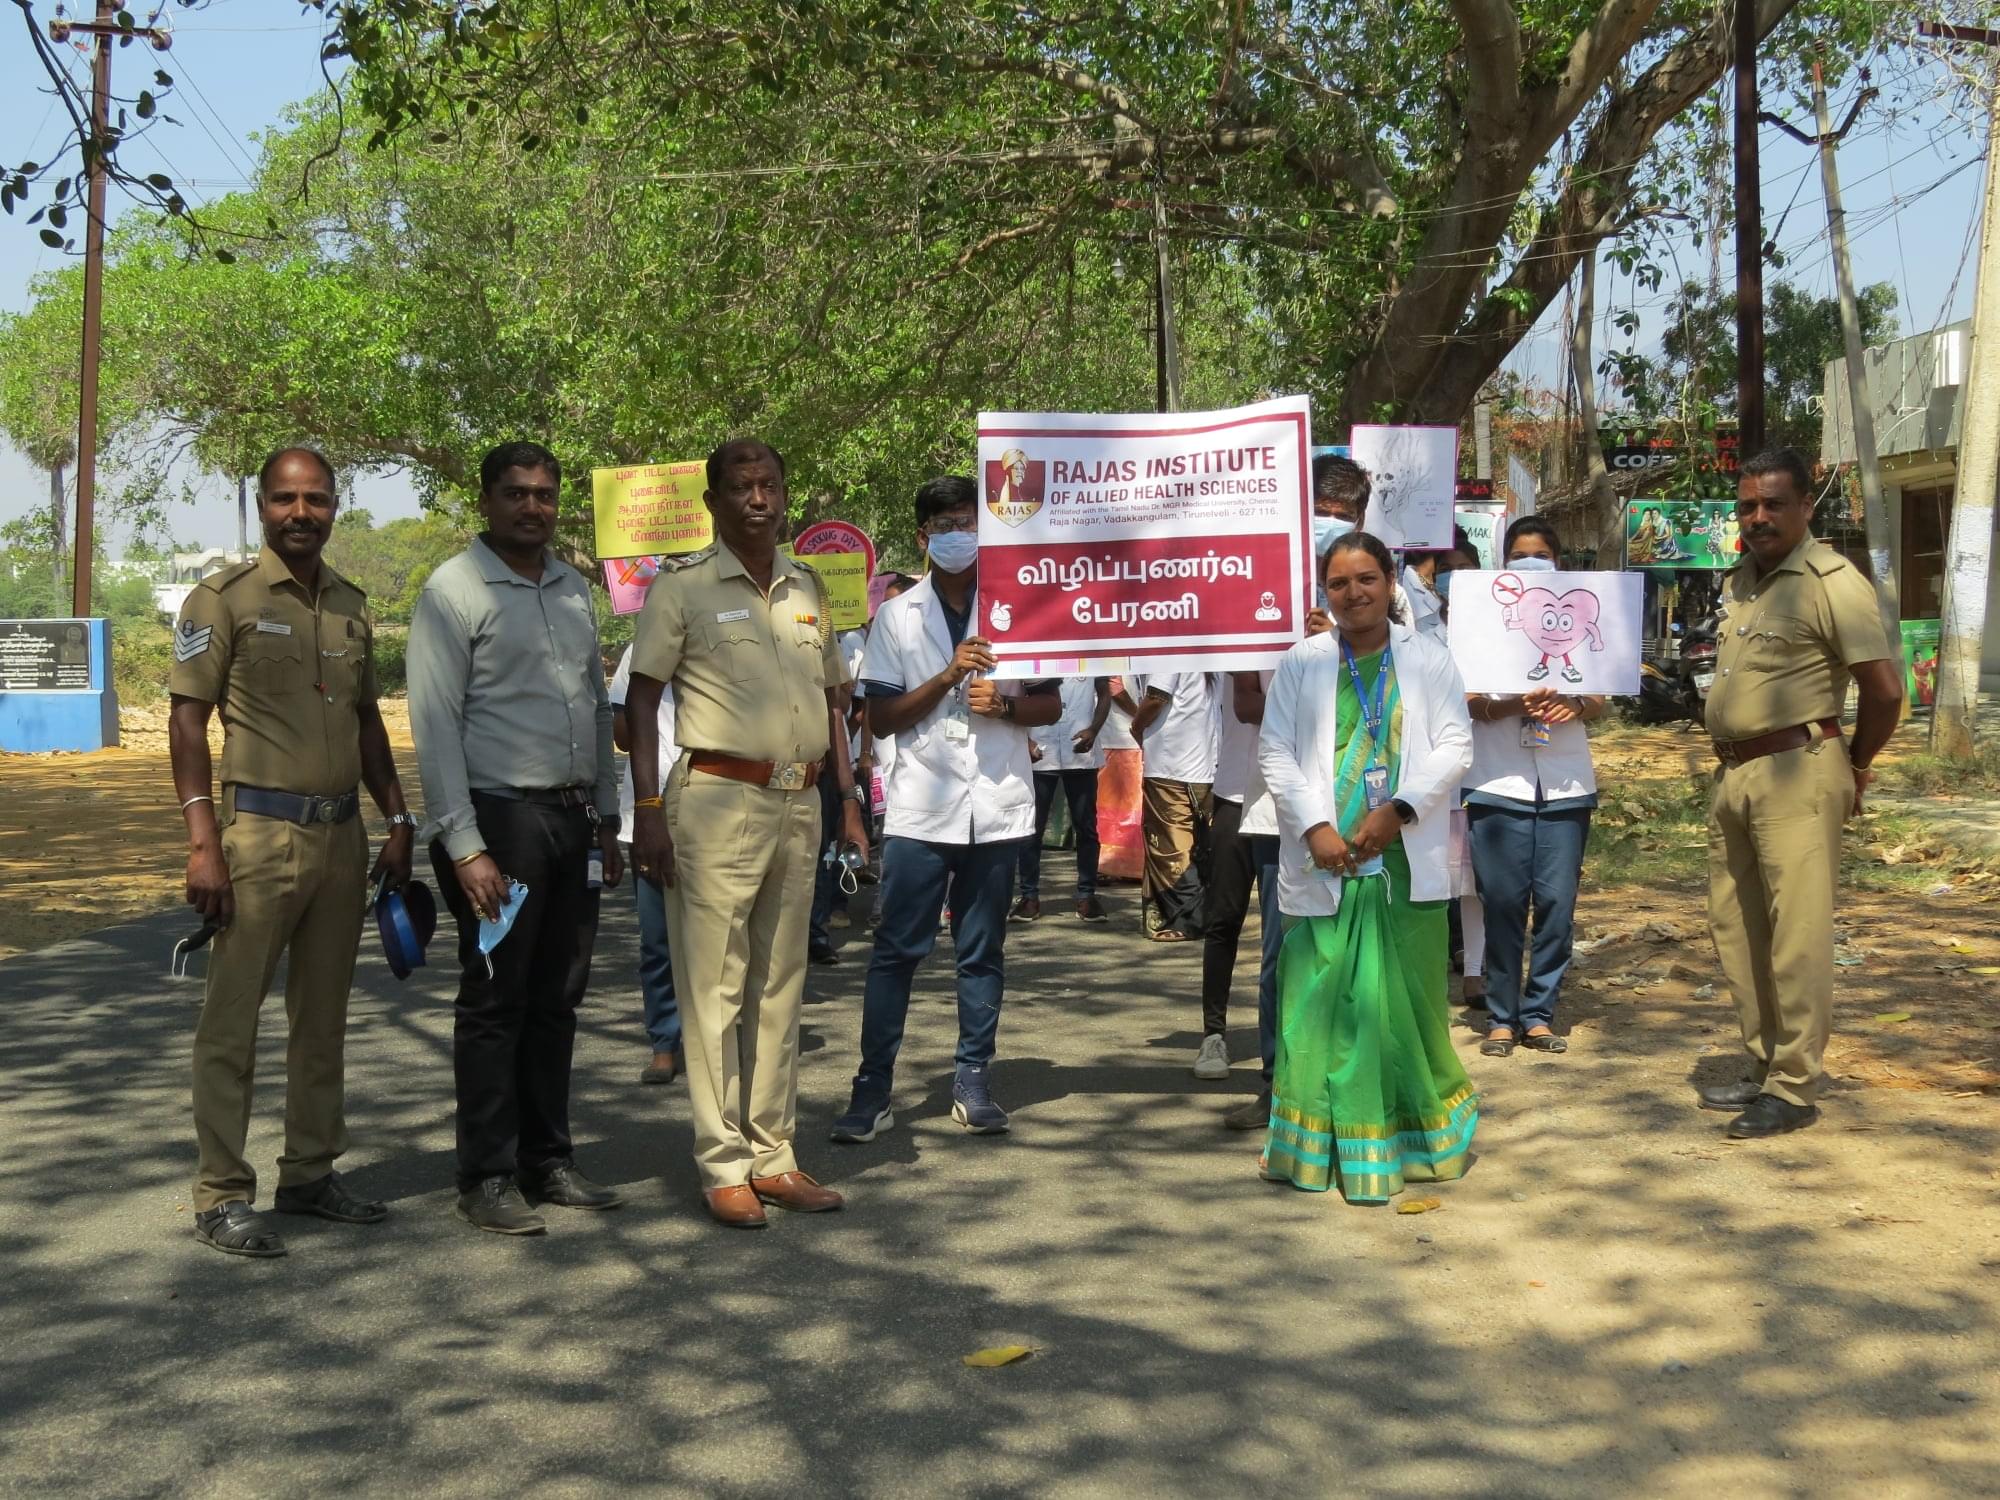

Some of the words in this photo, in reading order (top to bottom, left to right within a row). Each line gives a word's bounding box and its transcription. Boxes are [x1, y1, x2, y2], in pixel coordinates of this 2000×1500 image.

[1053, 460, 1137, 483] RAJAS
[1146, 447, 1276, 478] INSTITUTE
[1051, 490, 1071, 505] OF
[1075, 488, 1129, 504] ALLIED
[1134, 483, 1194, 500] HEALTH
[1200, 478, 1278, 496] SCIENCES
[997, 505, 1032, 516] RAJAS
[1050, 518, 1070, 527] Raja
[1072, 516, 1101, 526] Nagar,
[1104, 512, 1180, 524] Vadakkangulam,
[1183, 510, 1230, 519] Tirunelveli
[1239, 508, 1255, 516] 627
[1082, 506, 1097, 514] with
[841, 533, 860, 549] DAY
[1018, 550, 1253, 591] விழிப்புணர்வு
[1072, 593, 1199, 627] பேரணி
